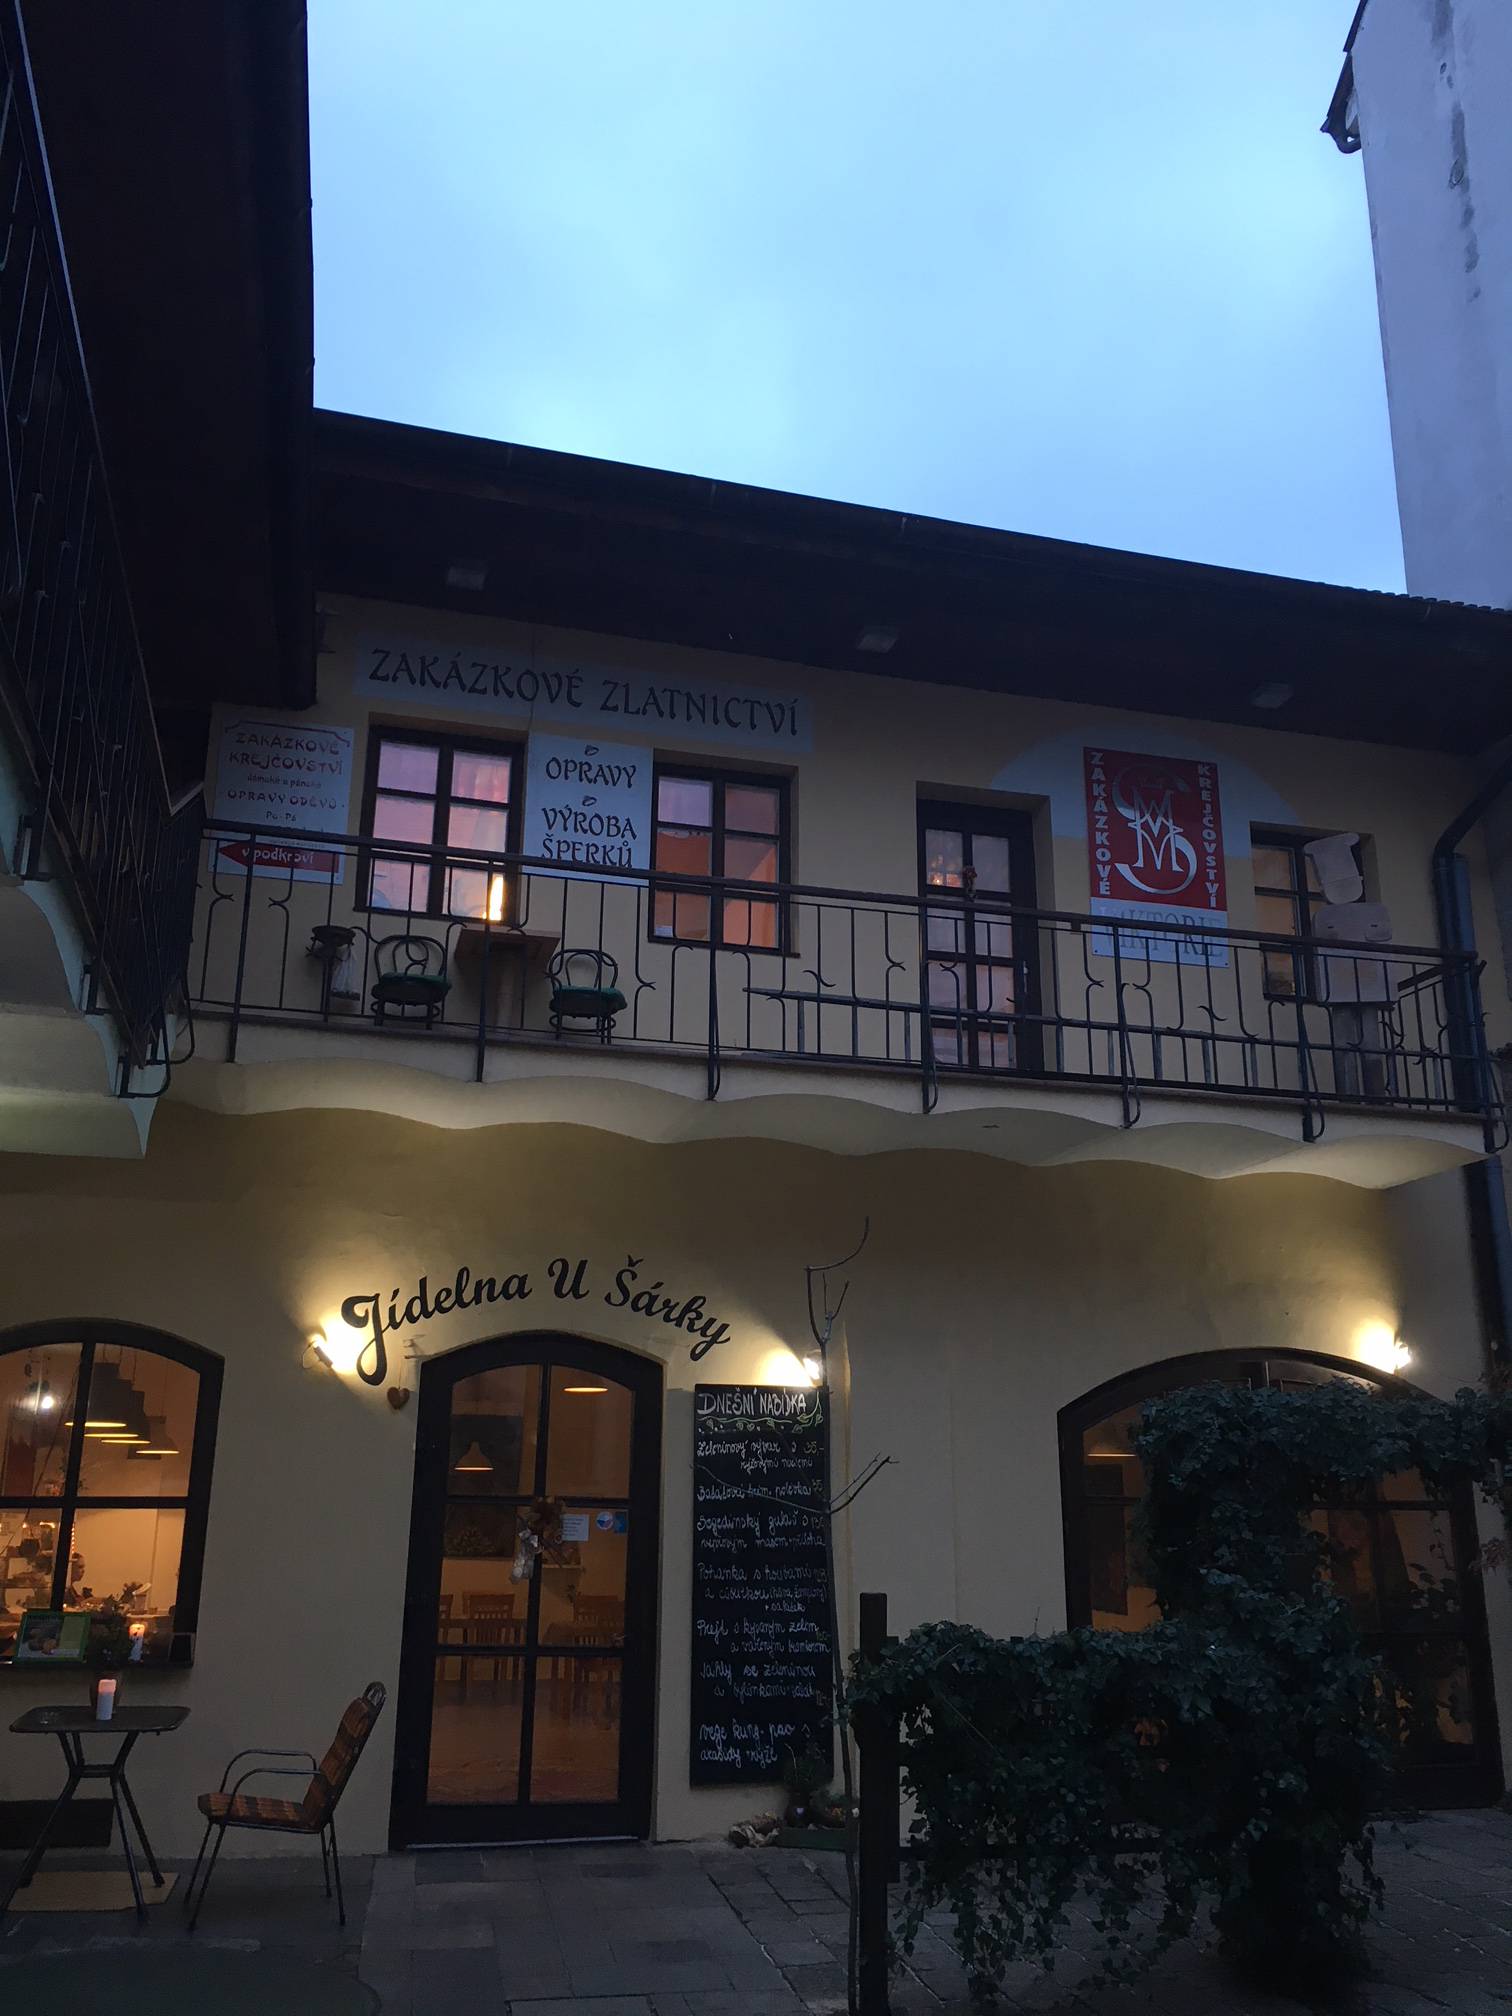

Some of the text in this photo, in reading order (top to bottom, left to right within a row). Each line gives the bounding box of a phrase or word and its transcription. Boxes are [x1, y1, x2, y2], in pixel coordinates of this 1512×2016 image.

[369, 649, 799, 736] ZAKÁZKOVÉ ZLATNICTVÍ
[229, 752, 343, 775] KREJČOVSTVÍ
[545, 756, 637, 789] OPRAVY
[227, 790, 286, 804] OPRAVY
[542, 803, 637, 841] VÝROBA
[1088, 752, 1111, 896] ZAKÁZKOVÉ
[1197, 762, 1220, 909] KREJČOVSTVÍ
[252, 847, 314, 864] podkroví
[540, 837, 633, 870] ŠPERKŮ
[341, 1254, 731, 1386] Jídelna U Šárky
[697, 1387, 807, 1417] DNEŠNÍ NABÍDKA
